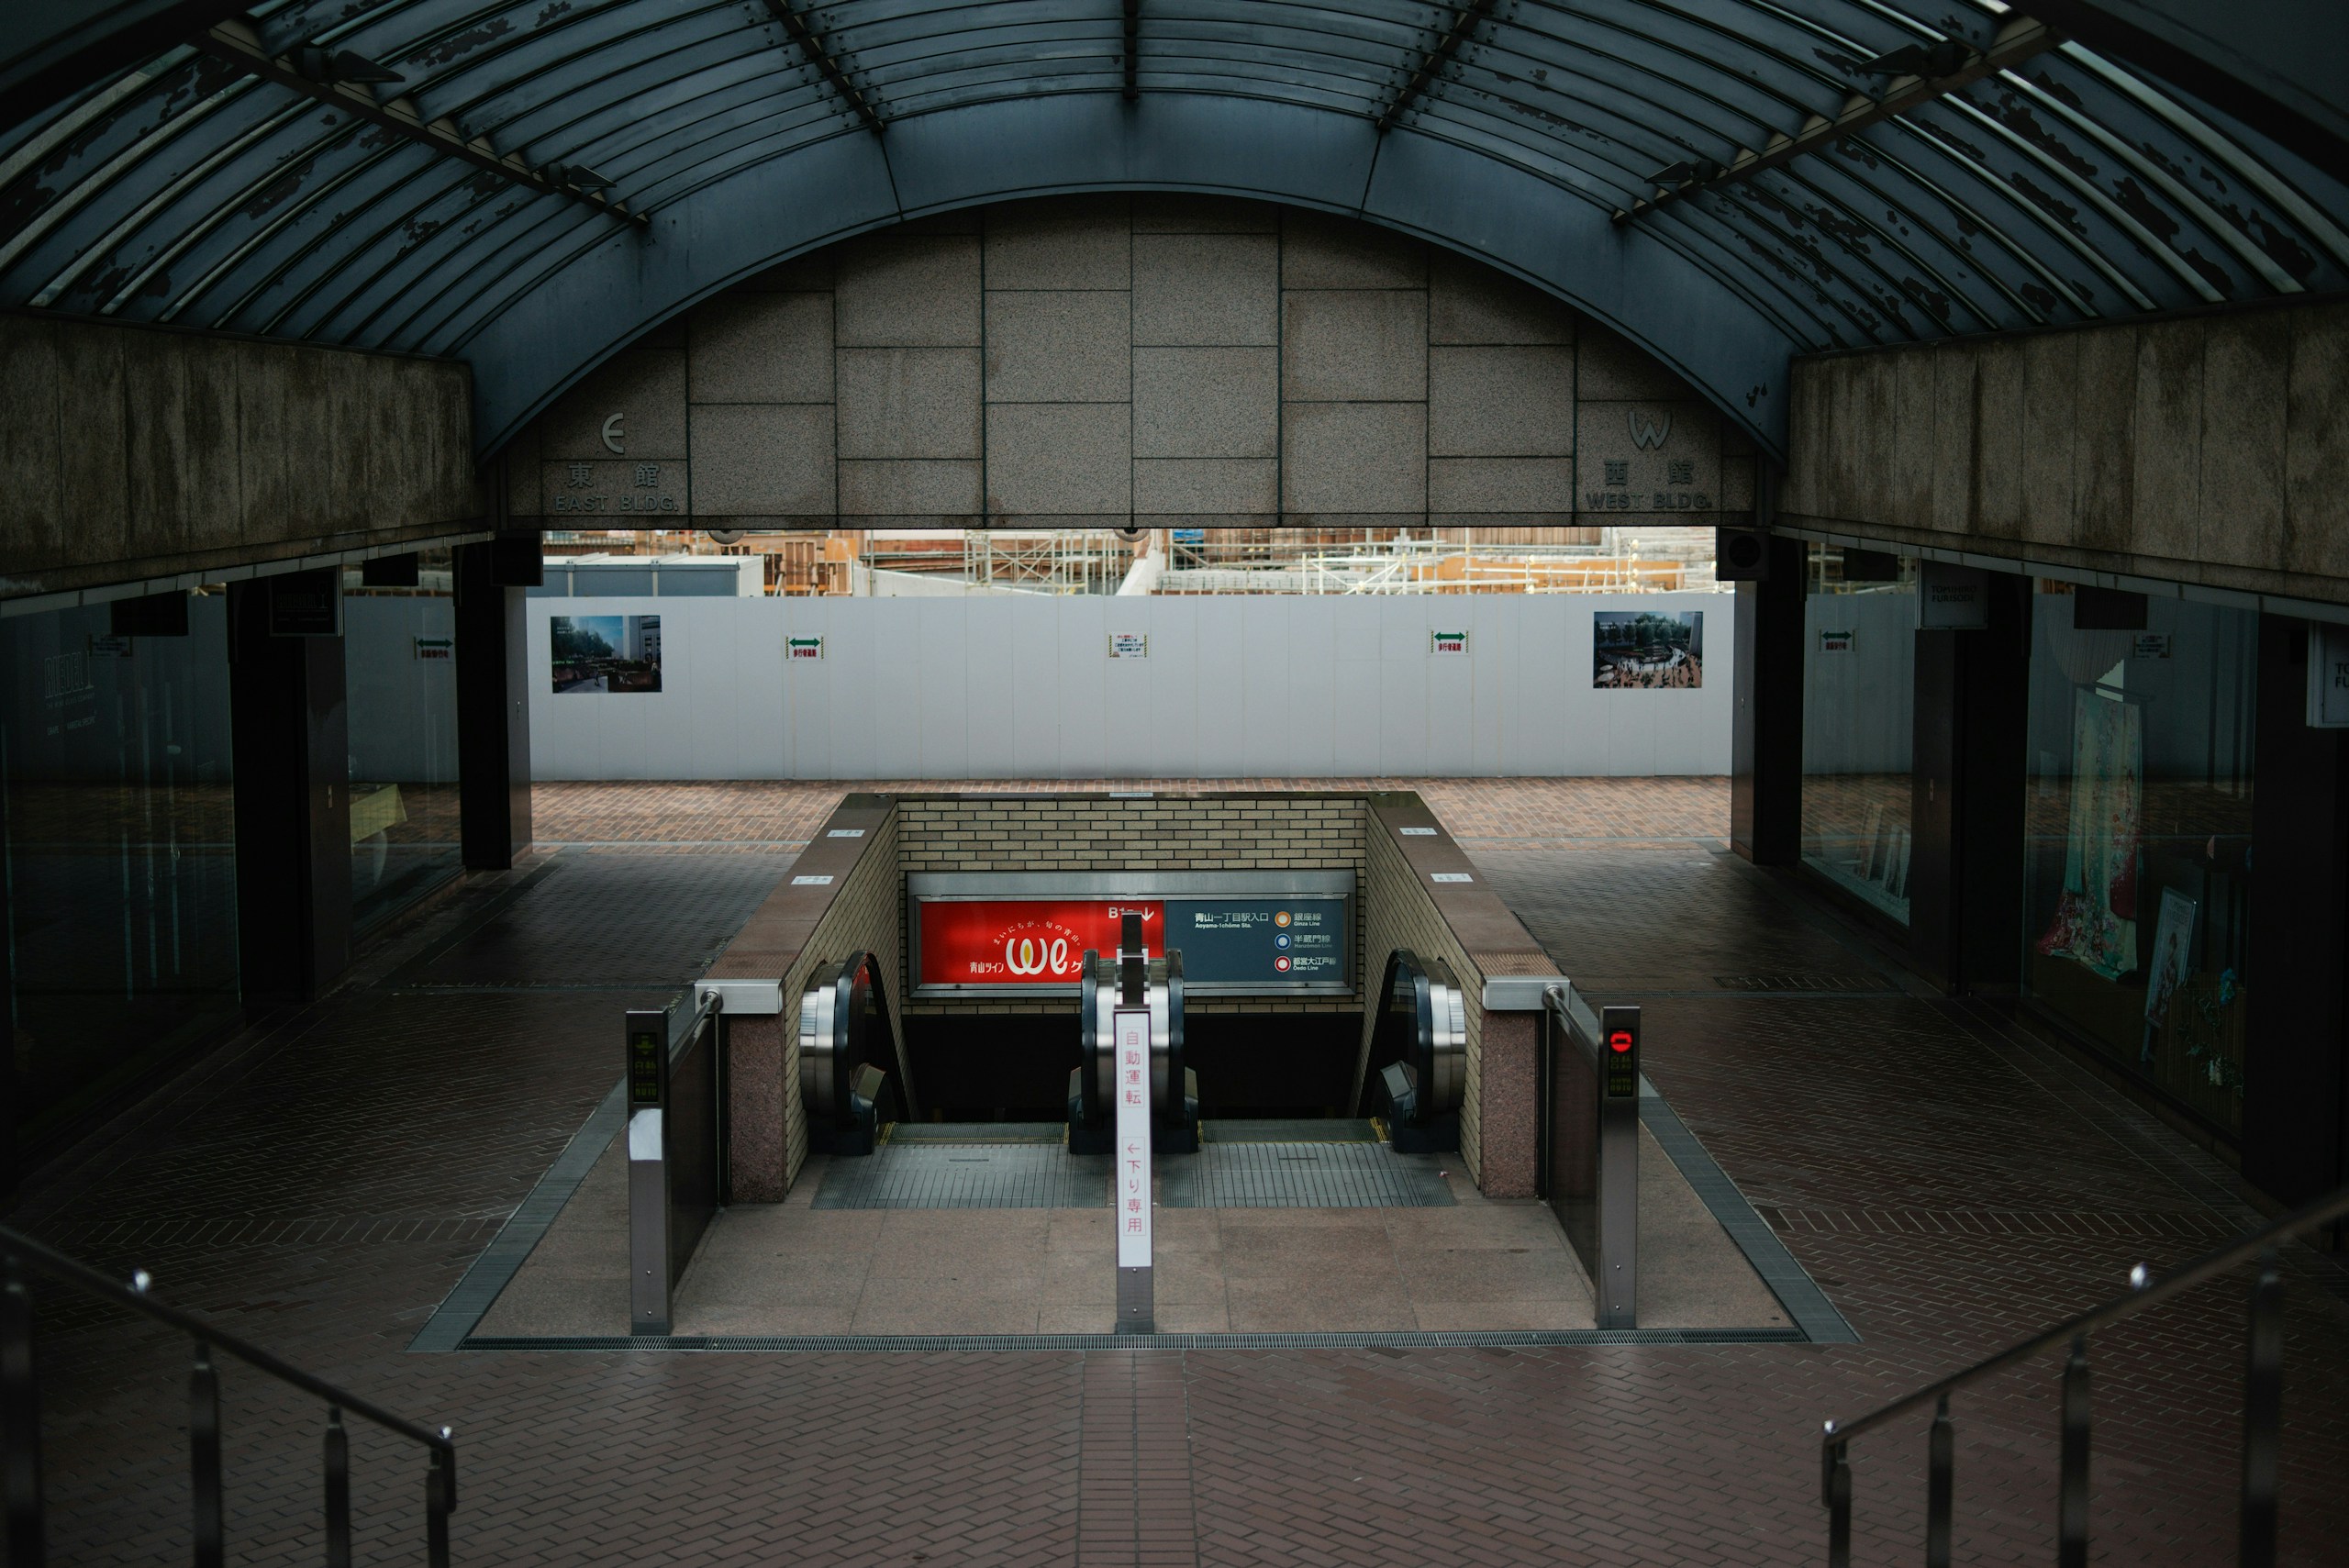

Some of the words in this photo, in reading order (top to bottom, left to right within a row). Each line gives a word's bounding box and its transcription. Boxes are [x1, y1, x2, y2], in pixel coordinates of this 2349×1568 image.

[567, 462, 660, 488] 東館
[1603, 460, 1695, 486] 西館
[554, 495, 608, 511] EAST
[619, 495, 679, 512] BLDG.
[1586, 493, 1644, 509] WEST
[1653, 493, 1712, 509] BLDG.
[1930, 584, 1976, 594] TOMIHIRO
[1932, 594, 1975, 603] FURISODE
[1195, 912, 1269, 922] 青山一丁目駅入口
[1294, 912, 1321, 921] 銀座線
[1295, 934, 1330, 943] 半蔵門線
[970, 961, 1005, 973] 青山ツイン
[1125, 1029, 1141, 1106] 自動運転
